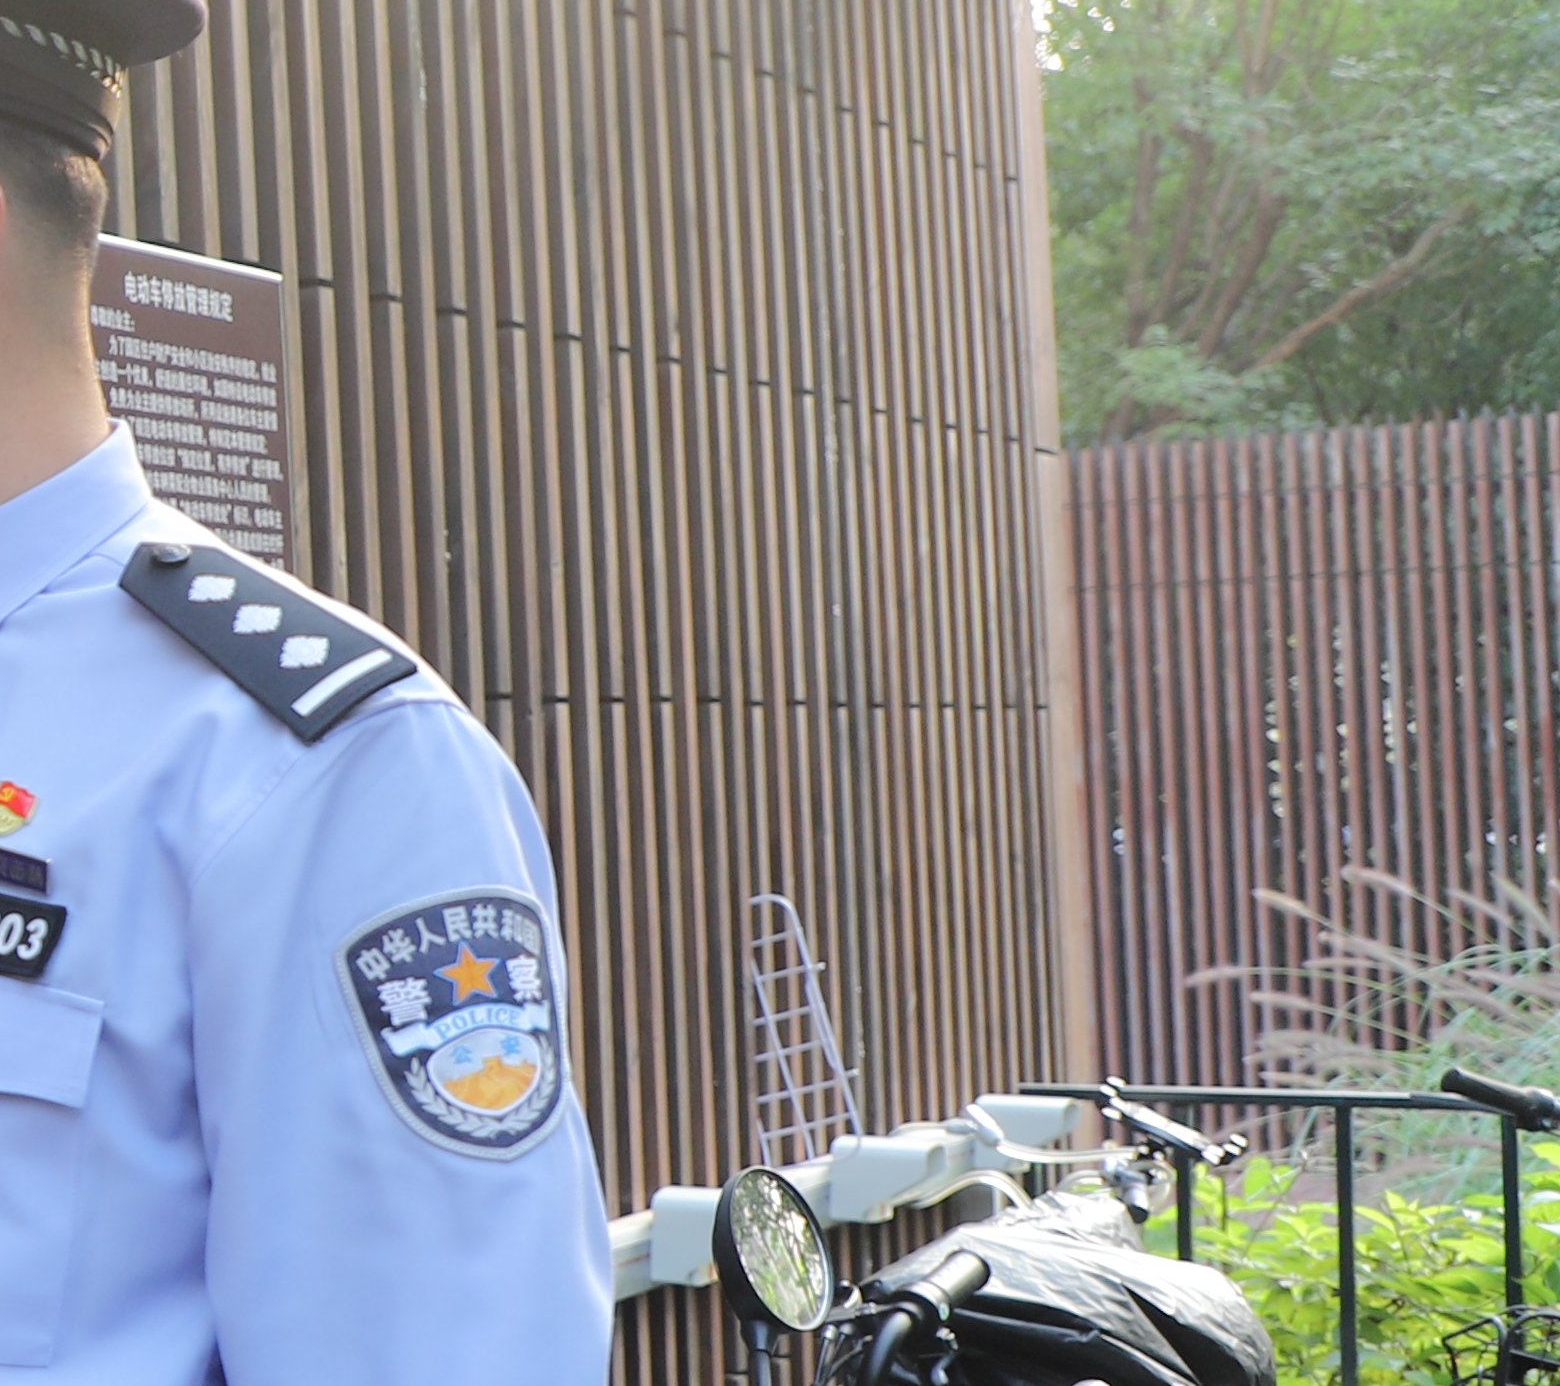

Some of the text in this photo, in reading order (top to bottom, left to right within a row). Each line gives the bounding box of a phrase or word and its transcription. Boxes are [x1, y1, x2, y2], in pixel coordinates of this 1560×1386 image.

[356, 903, 542, 981] 中华人民共和国
[378, 977, 432, 1026] 警
[433, 1007, 522, 1043] POLICE
